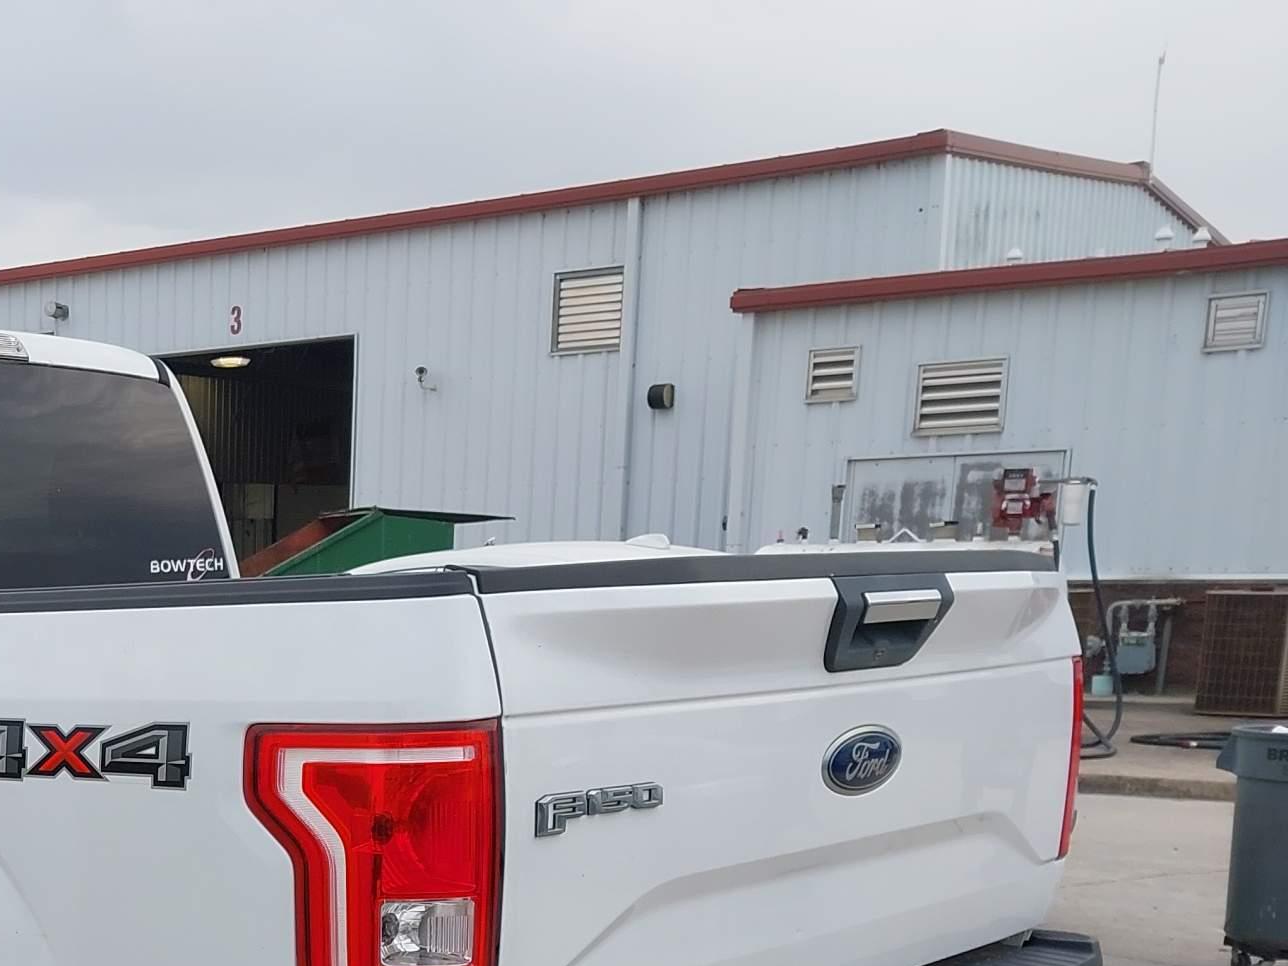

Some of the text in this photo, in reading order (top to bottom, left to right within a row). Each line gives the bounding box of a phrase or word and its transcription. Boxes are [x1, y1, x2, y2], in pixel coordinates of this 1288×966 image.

[230, 305, 242, 336] 3
[150, 557, 224, 575] BOWTECH
[845, 741, 891, 781] Ford
